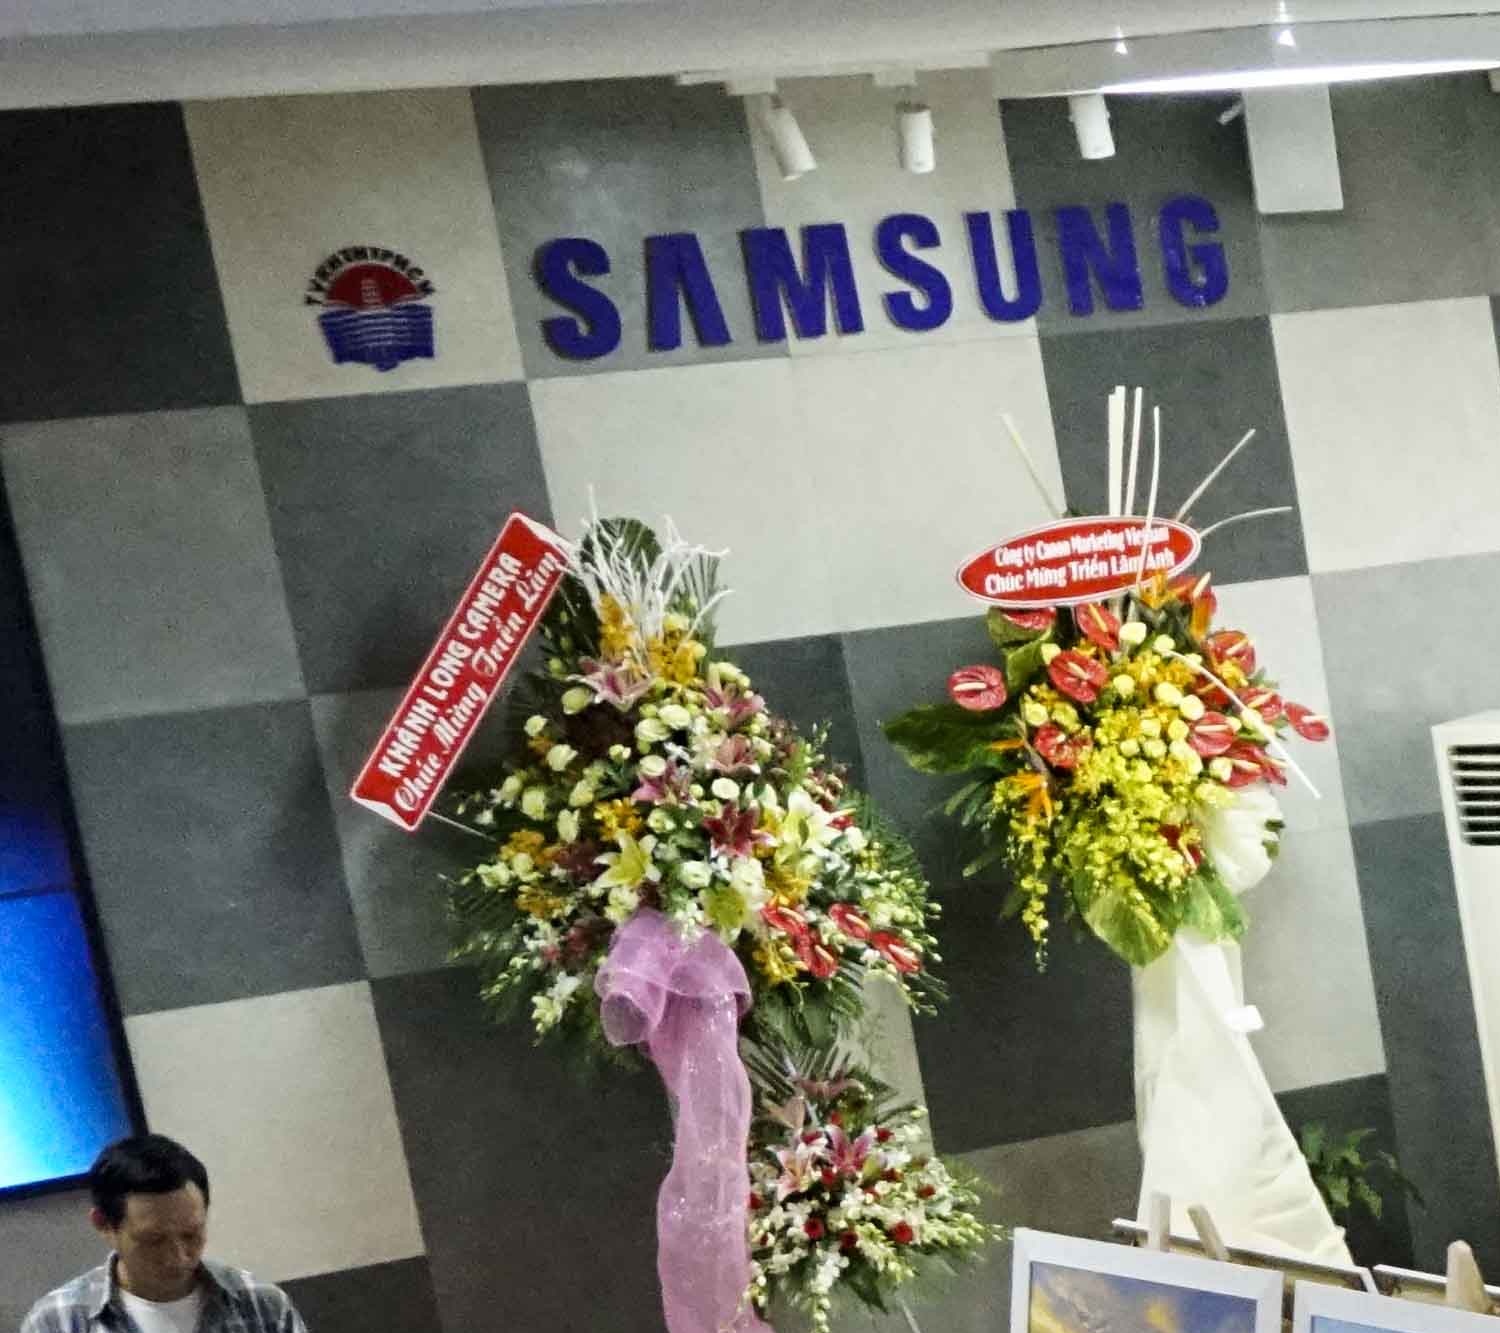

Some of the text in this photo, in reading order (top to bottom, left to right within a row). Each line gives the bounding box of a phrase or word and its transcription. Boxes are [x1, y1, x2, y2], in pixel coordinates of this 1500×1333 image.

[533, 194, 1229, 361] SAMSUNG
[984, 572, 1025, 595] Chúc
[378, 552, 524, 778] KHÁNH LONG CAMERA
[394, 752, 443, 812] Chúc
